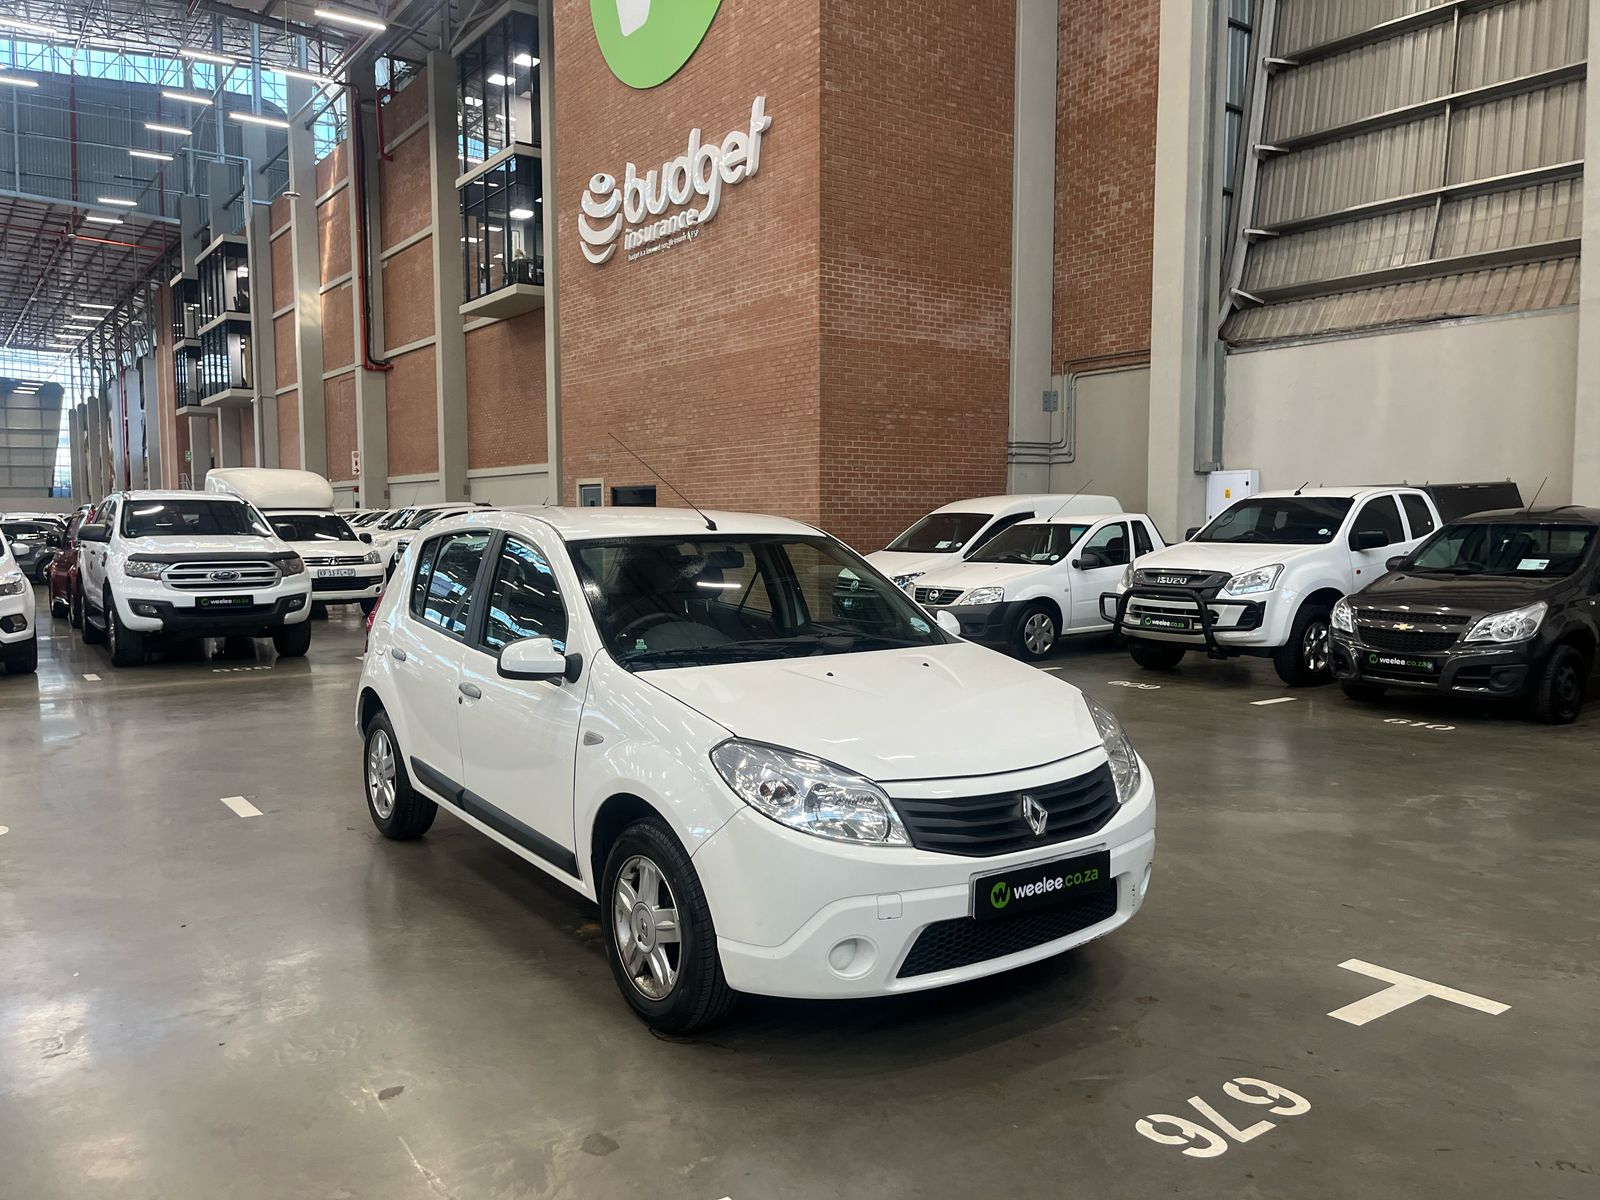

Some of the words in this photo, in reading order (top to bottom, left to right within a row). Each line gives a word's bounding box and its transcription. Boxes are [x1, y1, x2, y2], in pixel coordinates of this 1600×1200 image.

[623, 96, 772, 224] budget
[624, 208, 699, 251] insurance
[1157, 576, 1187, 585] ISUZU
[1151, 619, 1185, 628] weelee.co.za
[1379, 656, 1427, 668] weelee.co.za
[1013, 868, 1099, 899] weelee.co.za
